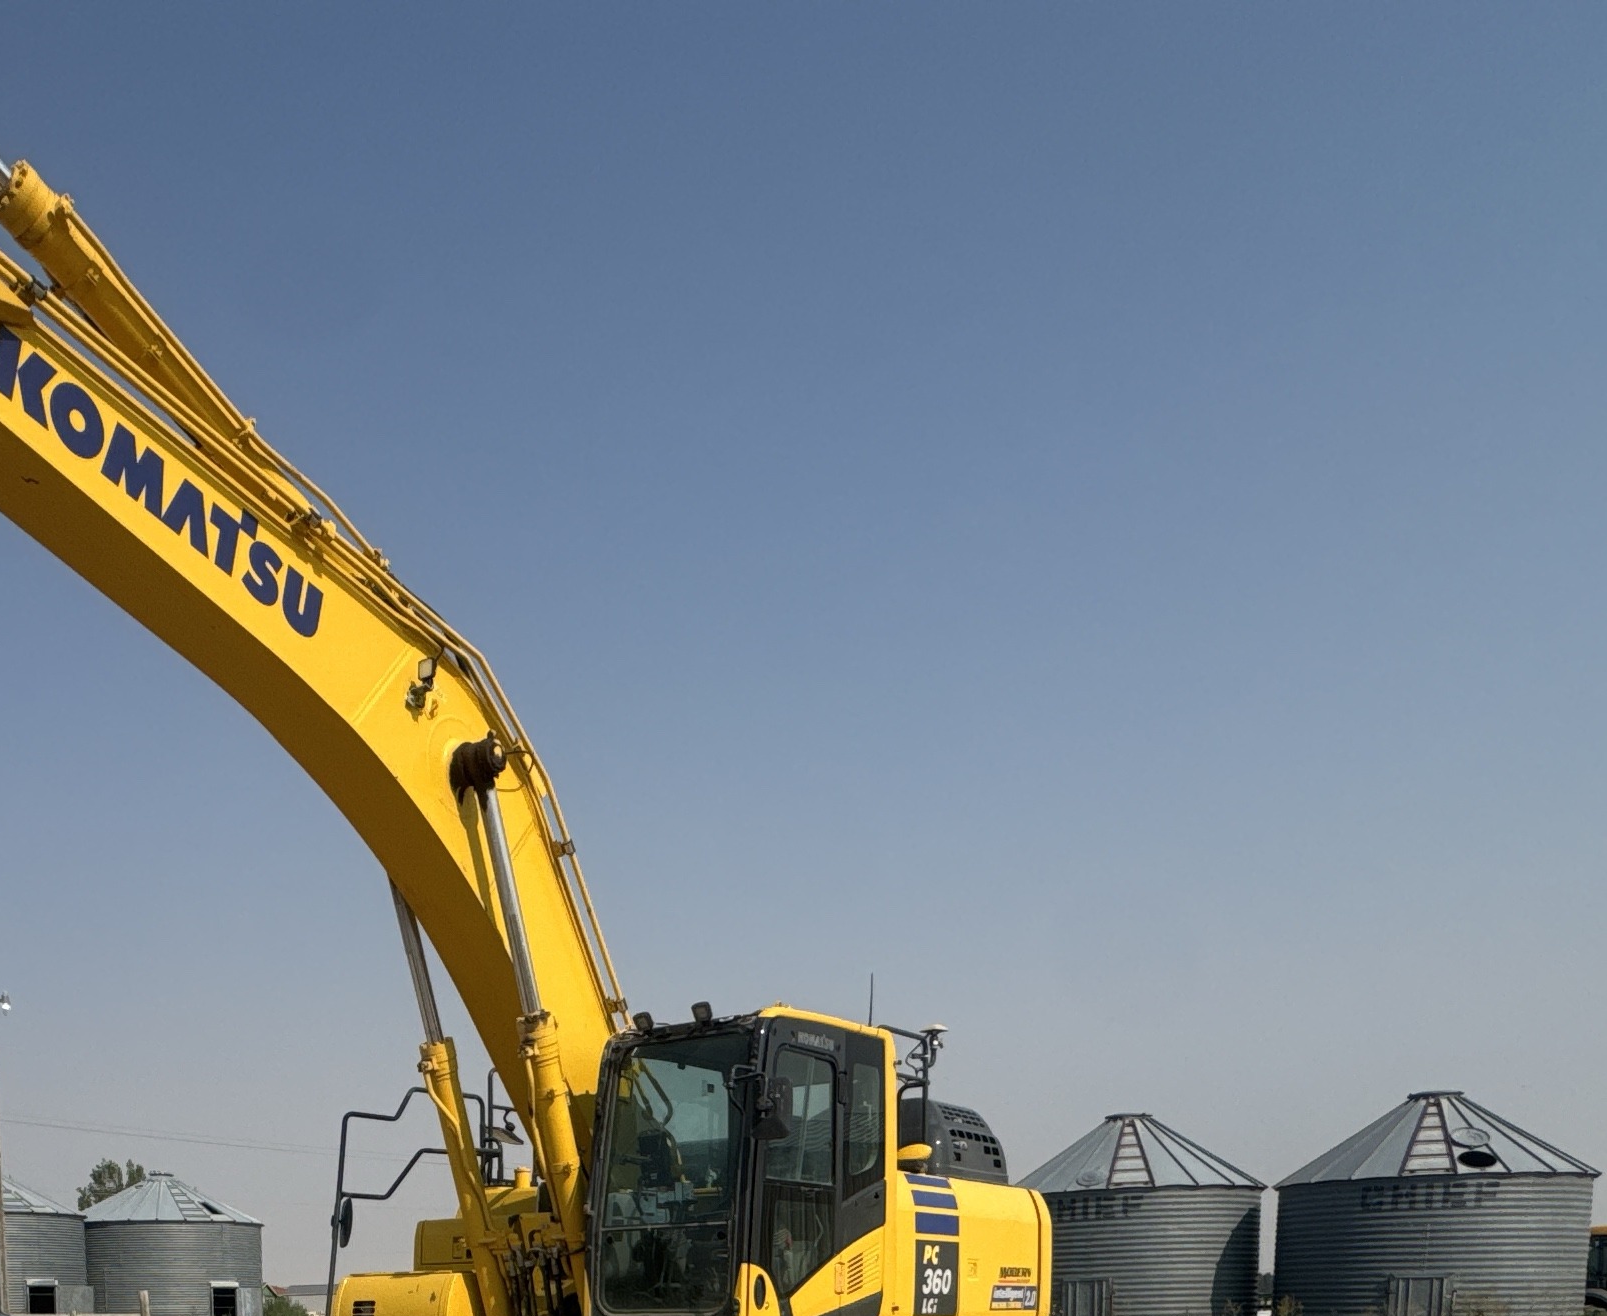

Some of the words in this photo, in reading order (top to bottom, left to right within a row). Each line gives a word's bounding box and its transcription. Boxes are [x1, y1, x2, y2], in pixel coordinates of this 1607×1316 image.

[1057, 1194, 1144, 1219] HIEF
[1360, 1181, 1501, 1210] CHIEF
[923, 1244, 940, 1265] PC
[921, 1268, 952, 1295] 360
[921, 1298, 938, 1315] LCi
